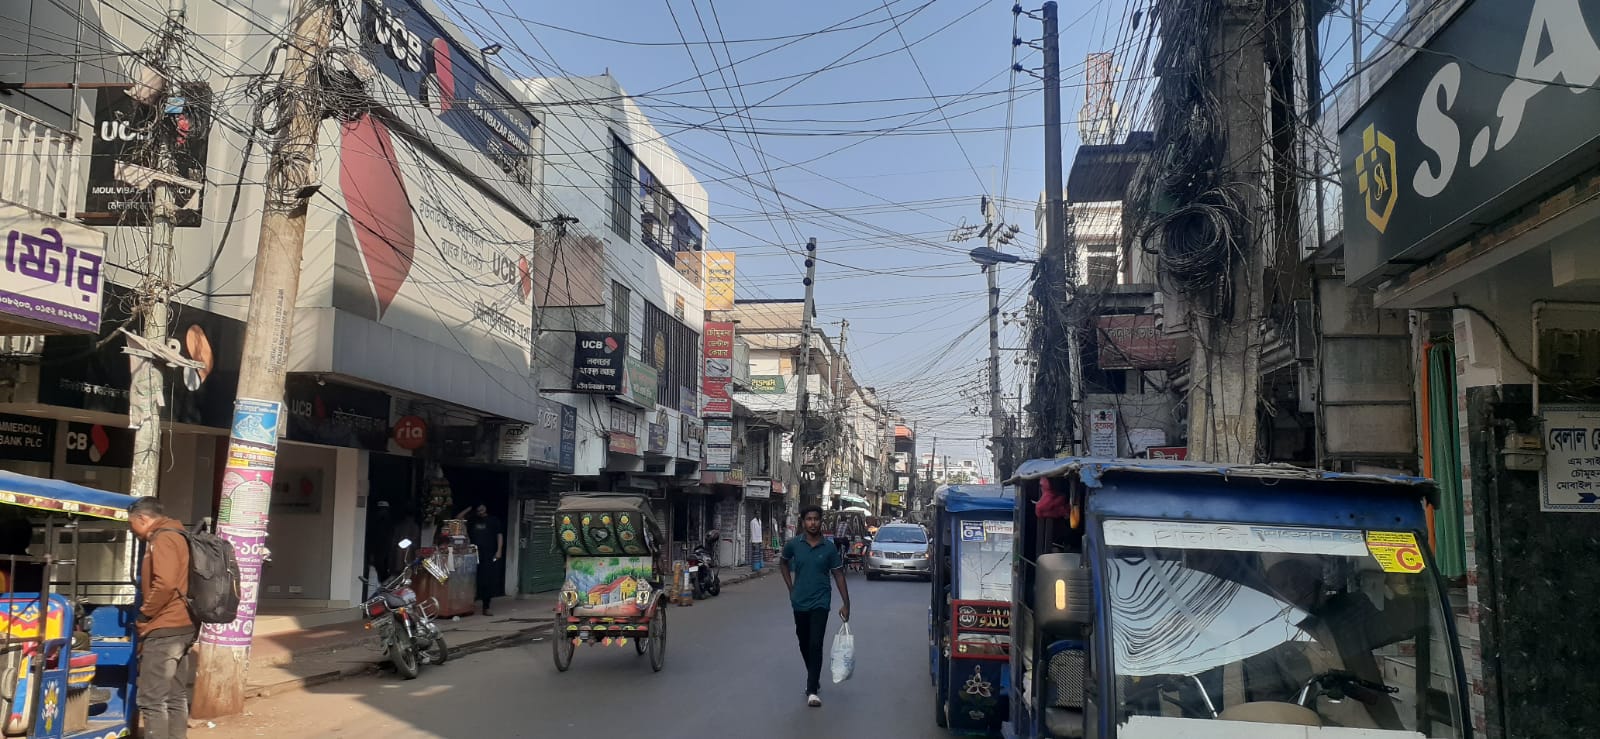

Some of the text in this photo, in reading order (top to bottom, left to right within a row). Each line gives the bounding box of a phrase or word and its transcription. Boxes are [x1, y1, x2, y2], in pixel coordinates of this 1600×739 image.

[375, 8, 422, 72] UCB
[493, 252, 516, 285] UCB
[581, 340, 603, 349] UCB
[291, 399, 312, 417] UCB
[397, 421, 423, 439] ria
[1549, 425, 1587, 452] বেলাল
